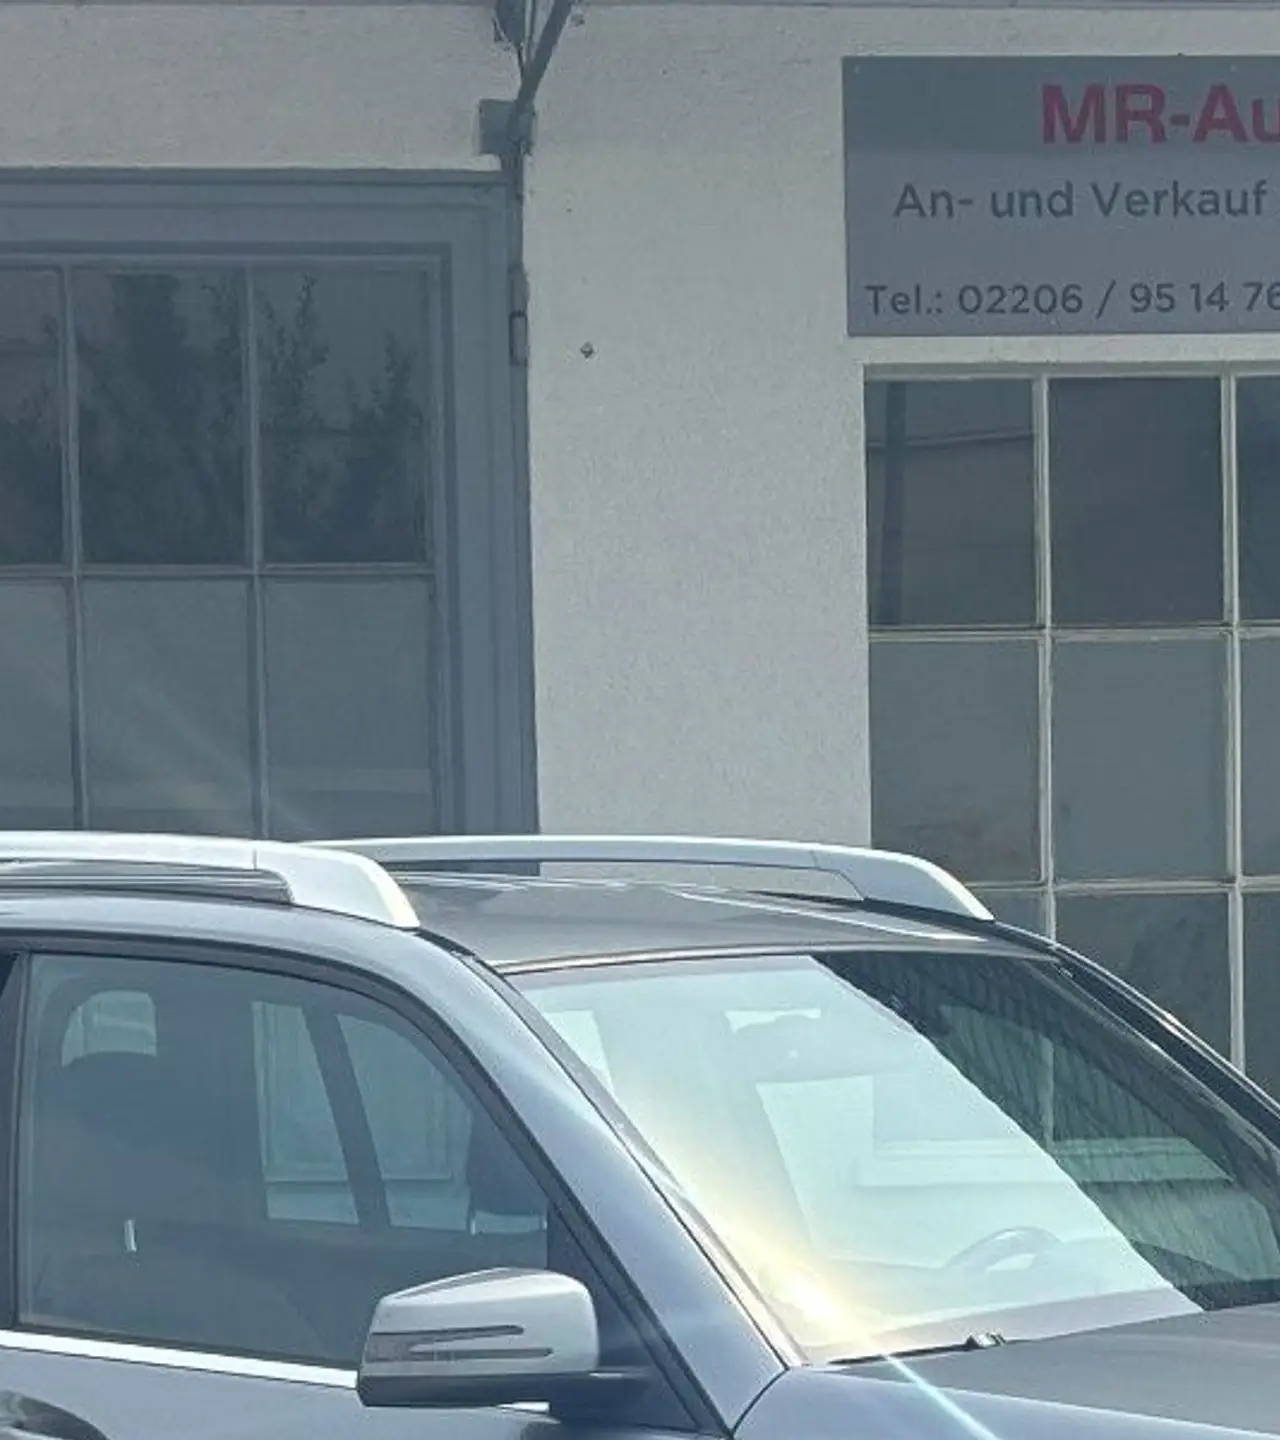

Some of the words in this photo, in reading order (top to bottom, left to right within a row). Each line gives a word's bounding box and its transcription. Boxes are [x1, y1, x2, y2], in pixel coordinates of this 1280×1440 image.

[892, 182, 973, 218] An-
[991, 180, 1075, 218] und
[1091, 178, 1268, 218] Verkauf
[864, 283, 943, 316] Tel.:
[957, 283, 1084, 315] 02206
[1096, 279, 1117, 321] /
[1129, 282, 1176, 314] 95
[1189, 281, 1230, 314] 14
